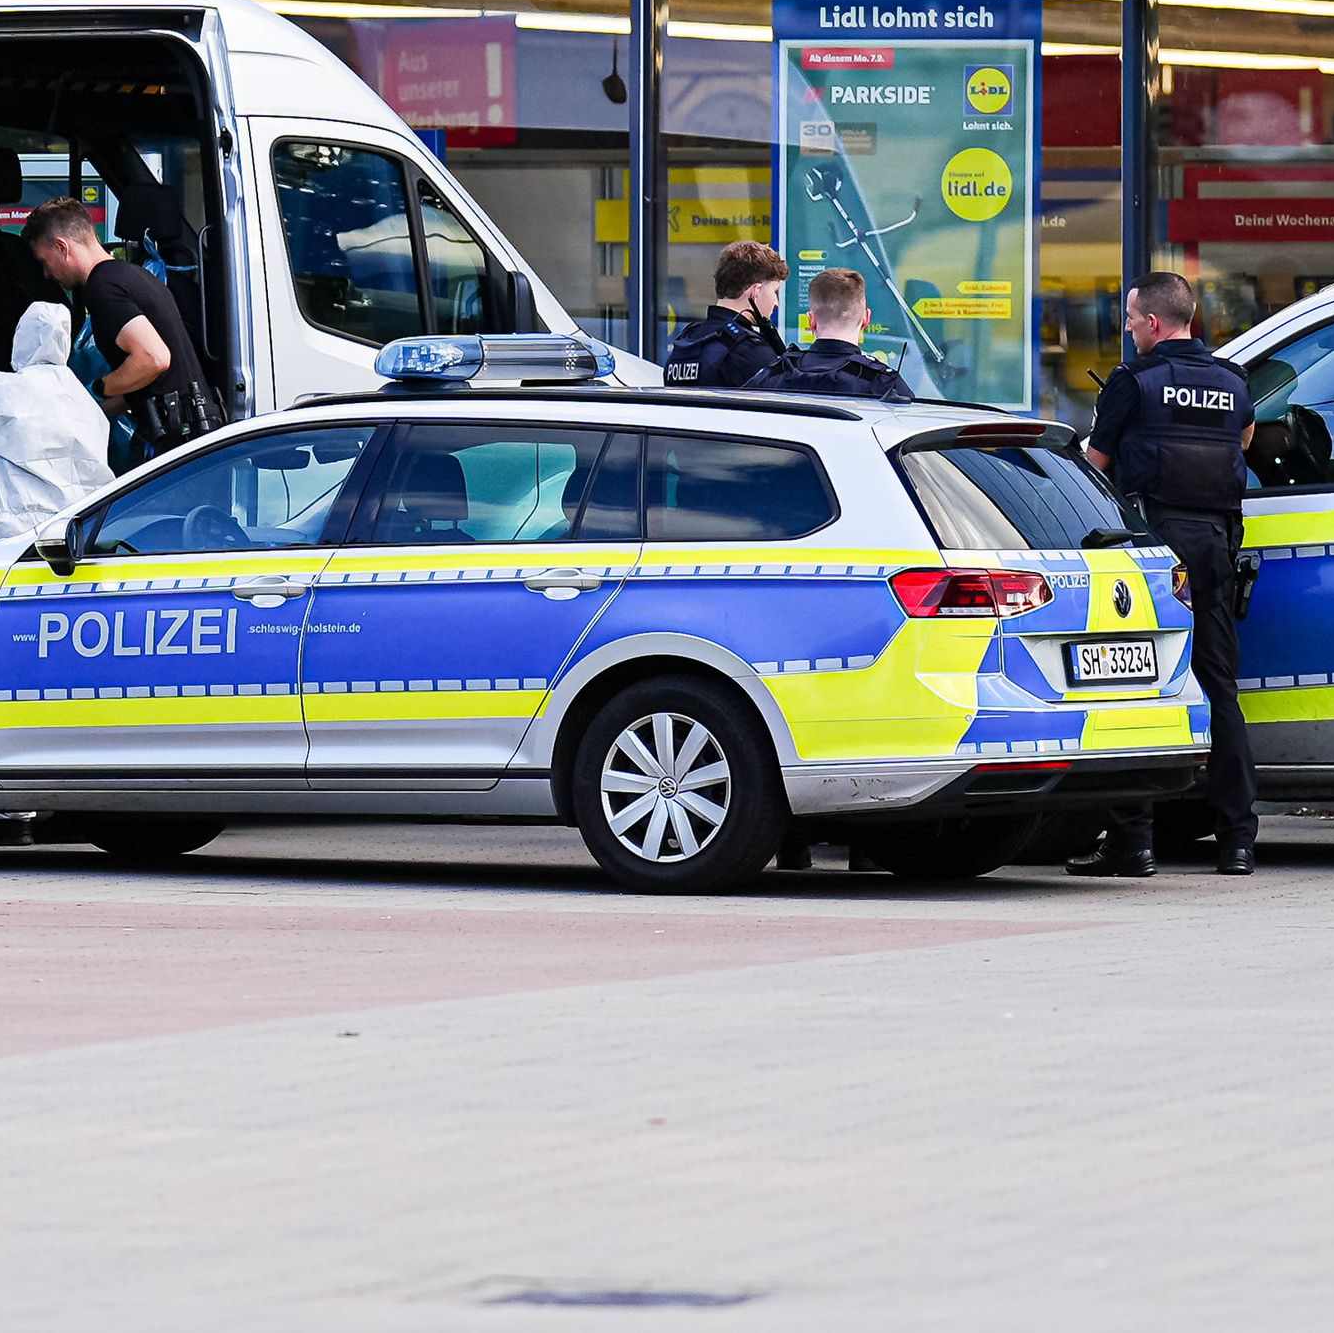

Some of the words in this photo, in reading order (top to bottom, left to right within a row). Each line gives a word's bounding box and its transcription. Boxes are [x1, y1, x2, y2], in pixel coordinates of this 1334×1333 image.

[820, 6, 865, 28] Lidl
[872, 7, 937, 28] lohnt
[943, 5, 994, 28] sich
[809, 54, 821, 63] Ab
[822, 54, 853, 63] diesem
[853, 54, 869, 63] Mo.
[830, 86, 931, 104] PARKSIDE
[962, 120, 990, 130] Lohnt
[991, 121, 1014, 130] sich.
[948, 181, 1006, 196] lidl.de
[1234, 214, 1273, 226] Deine
[667, 363, 699, 381] POLIZEI
[1163, 386, 1234, 411] POLIZEI
[1050, 575, 1089, 589] POLIZEI
[1082, 648, 1101, 675] SH
[1109, 646, 1152, 674] 33234
